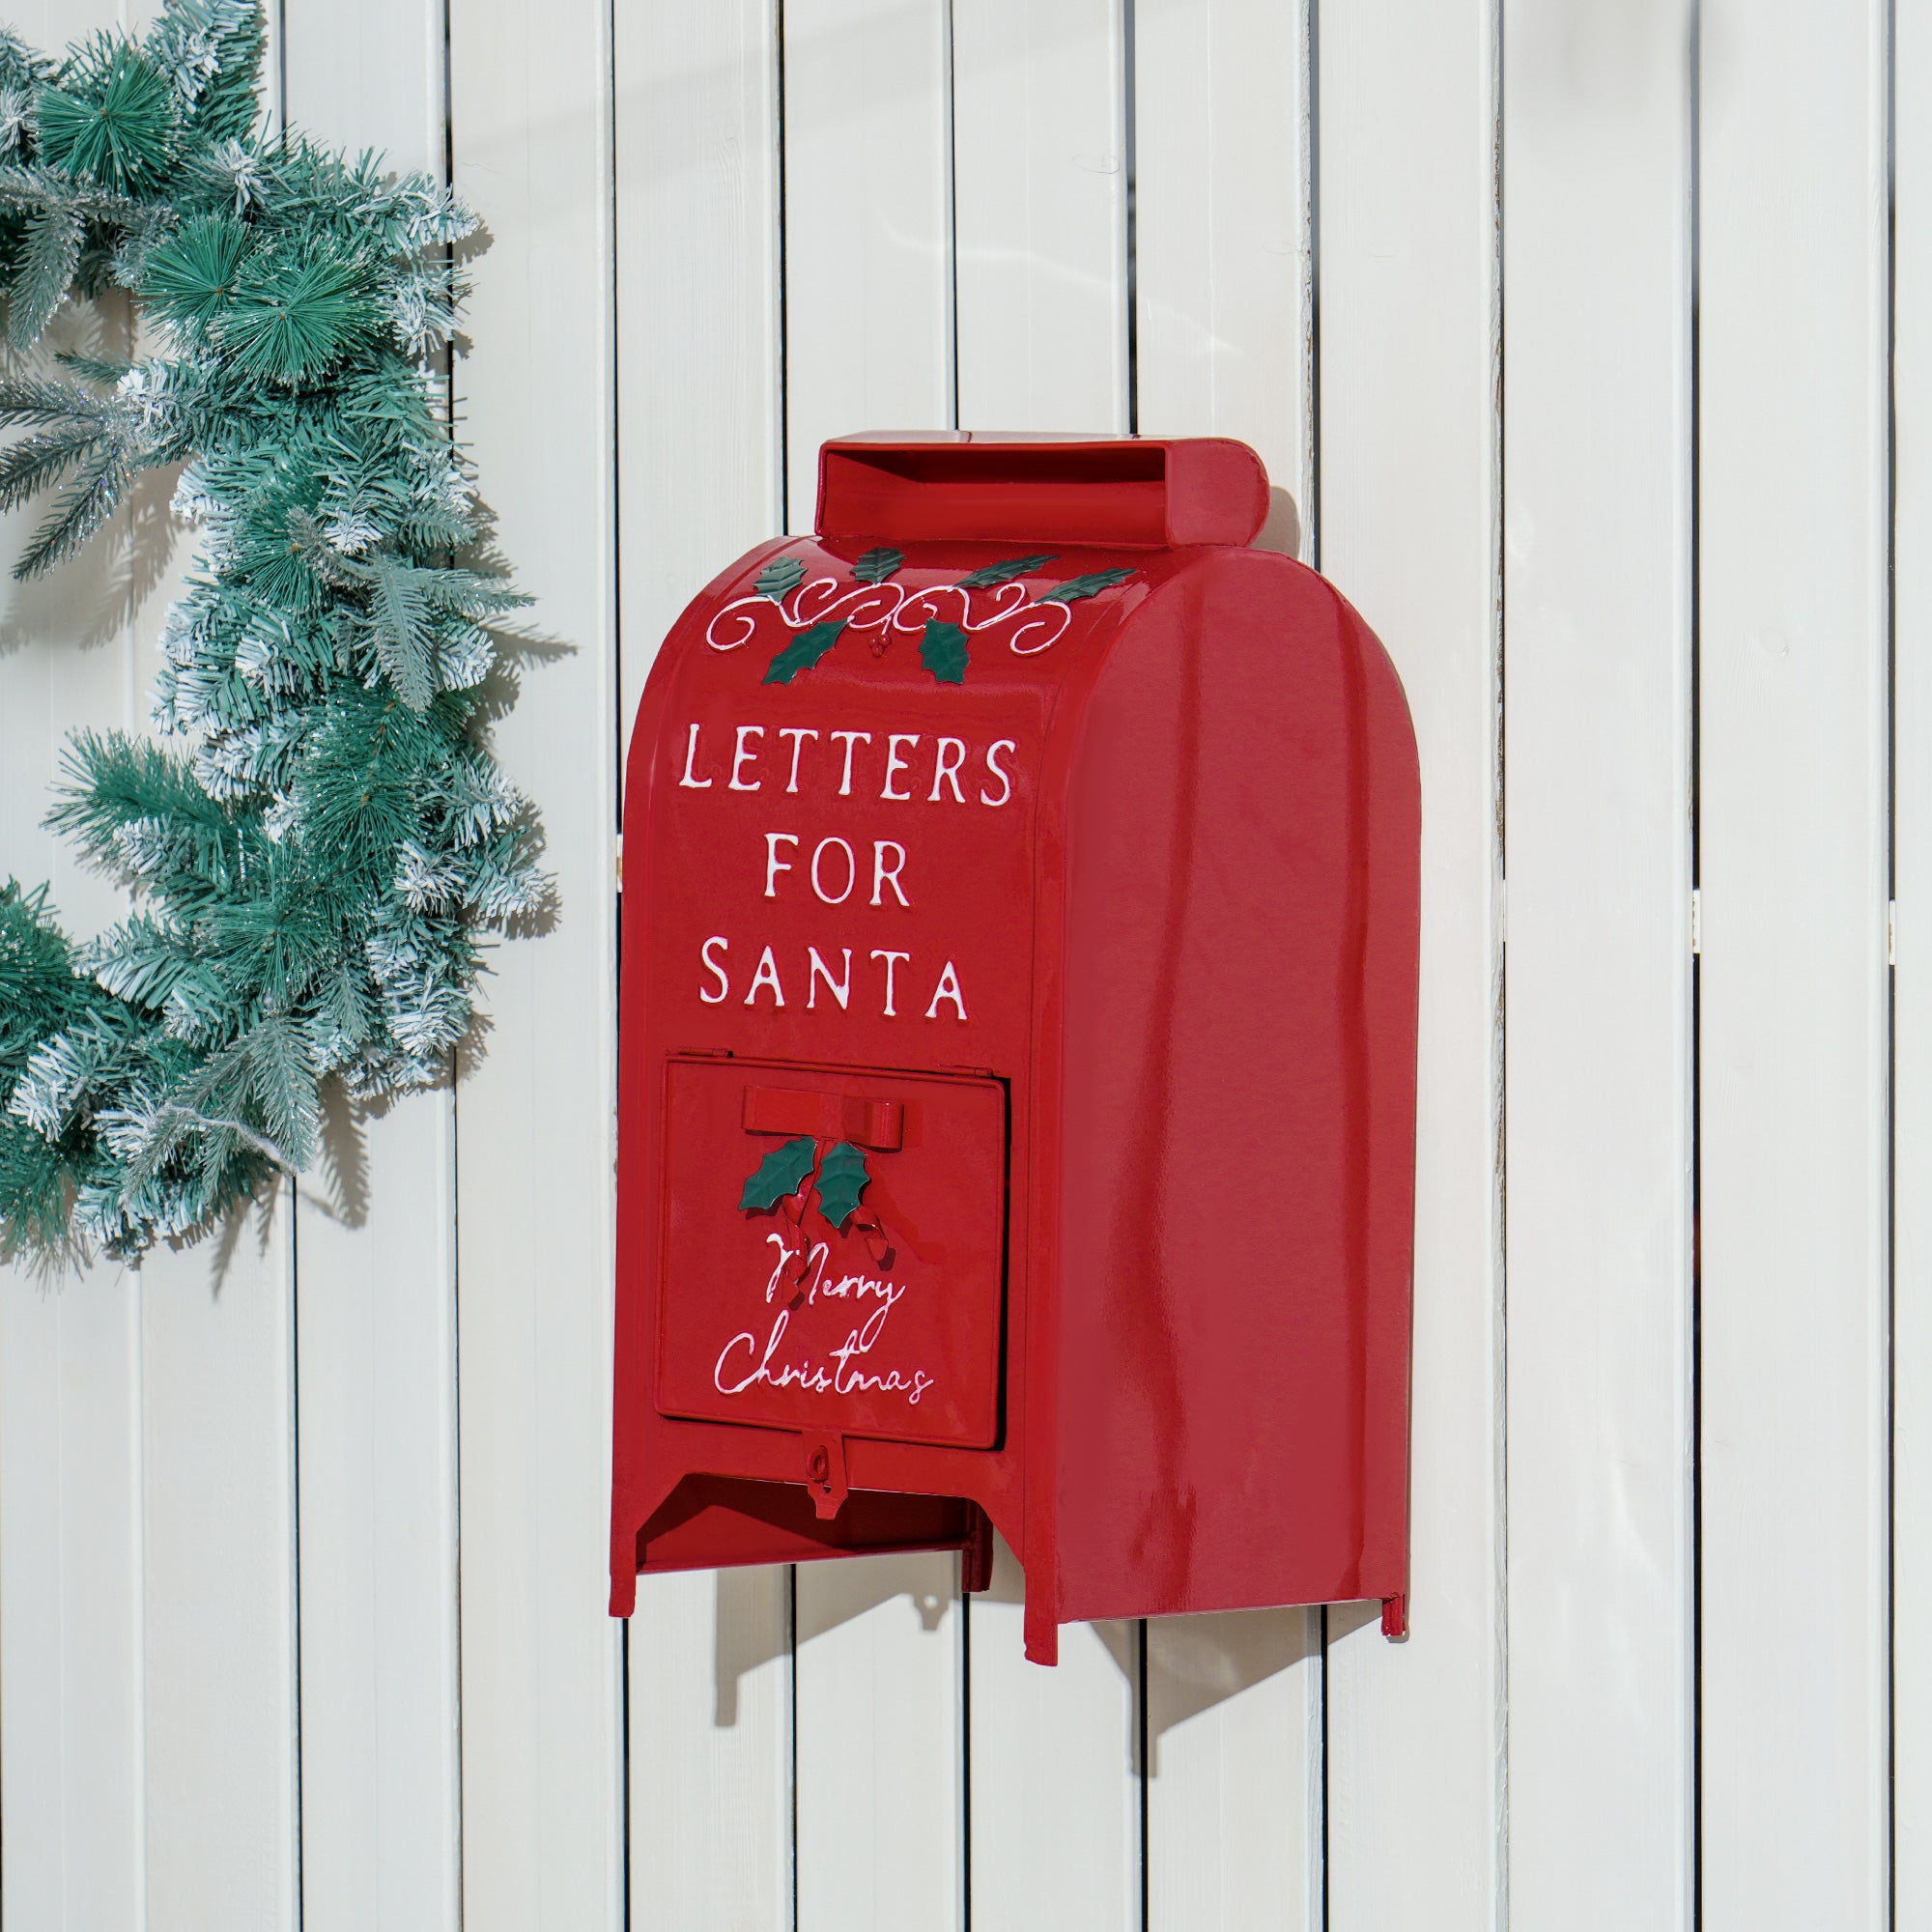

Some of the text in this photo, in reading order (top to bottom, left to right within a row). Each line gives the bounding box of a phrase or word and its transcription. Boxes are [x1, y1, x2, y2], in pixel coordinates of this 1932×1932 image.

[678, 723, 1016, 807] LETTERS
[763, 833, 910, 907] FOR
[699, 935, 968, 1020] SANTA
[765, 1233, 906, 1352] Merry
[714, 1309, 934, 1405] Christmas
